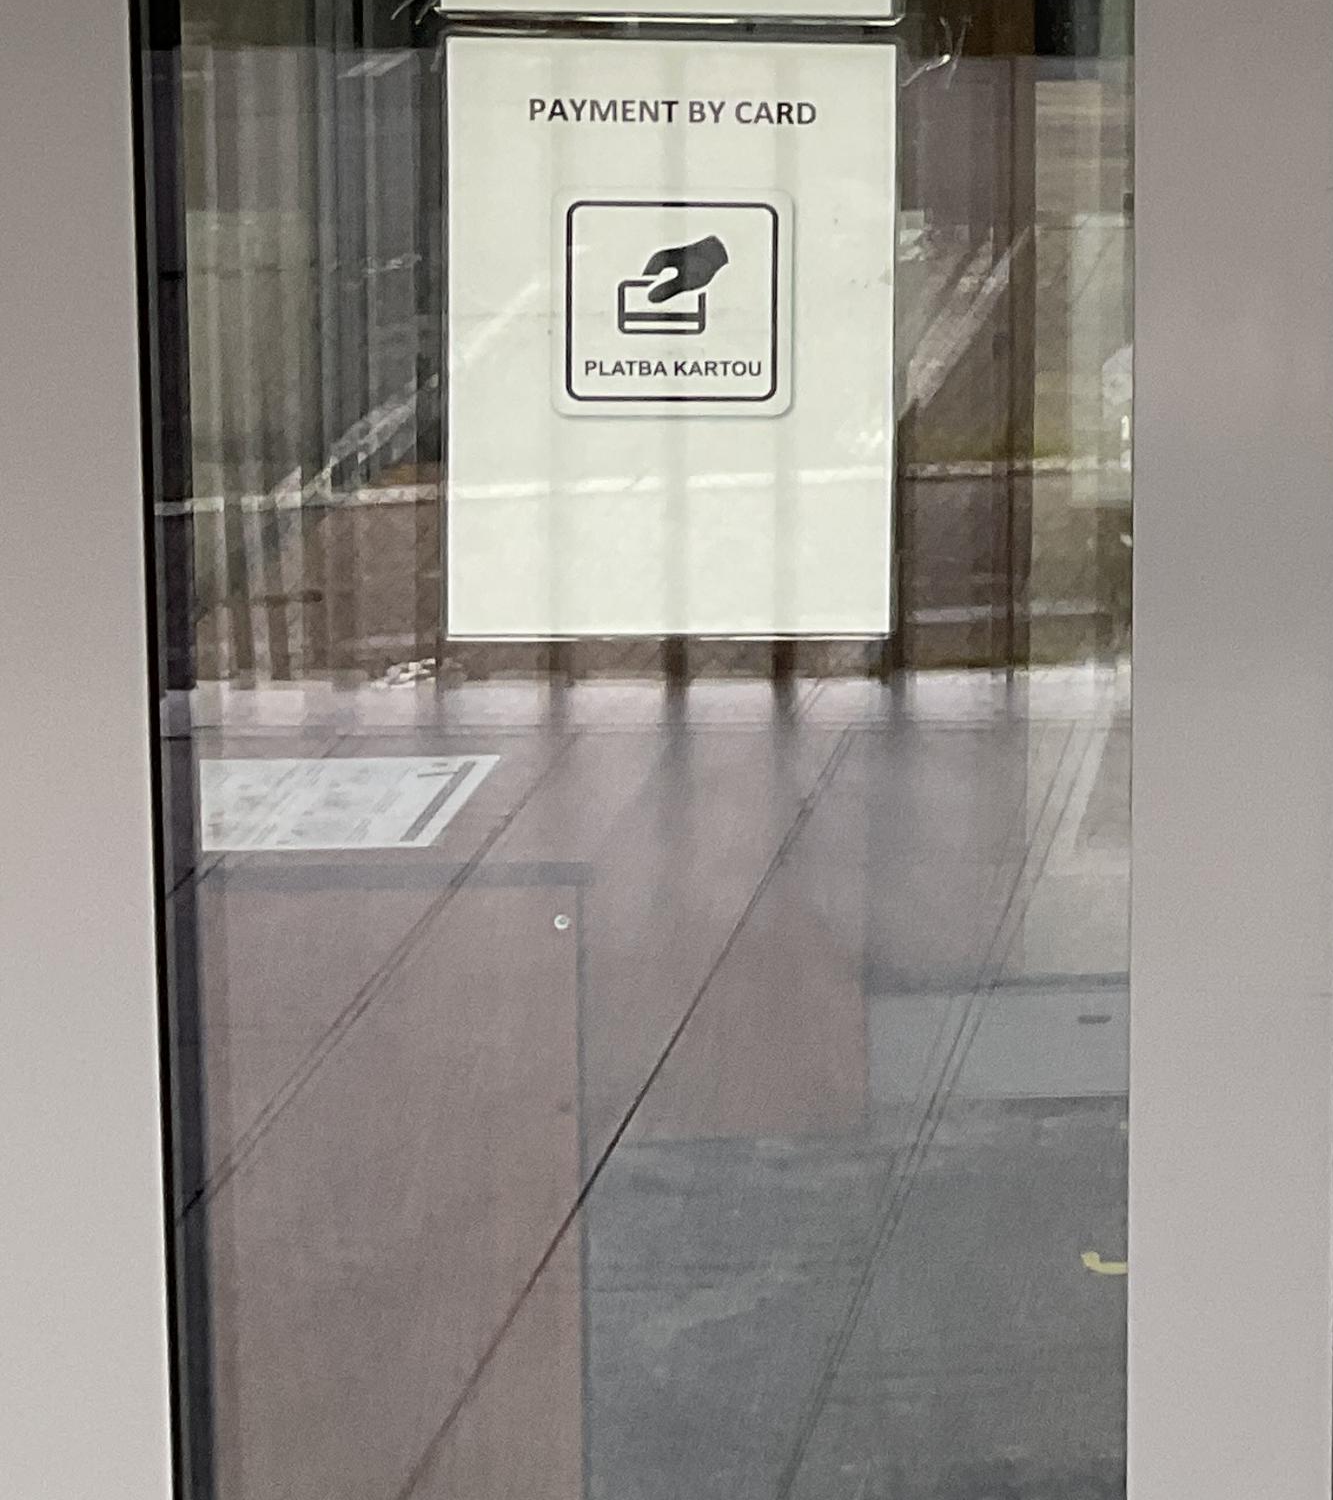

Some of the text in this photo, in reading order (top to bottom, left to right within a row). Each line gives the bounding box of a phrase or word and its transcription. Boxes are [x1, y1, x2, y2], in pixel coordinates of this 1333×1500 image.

[529, 97, 817, 125] PAYMENT BY CARD
[584, 360, 762, 377] PLATBA KARTOU
